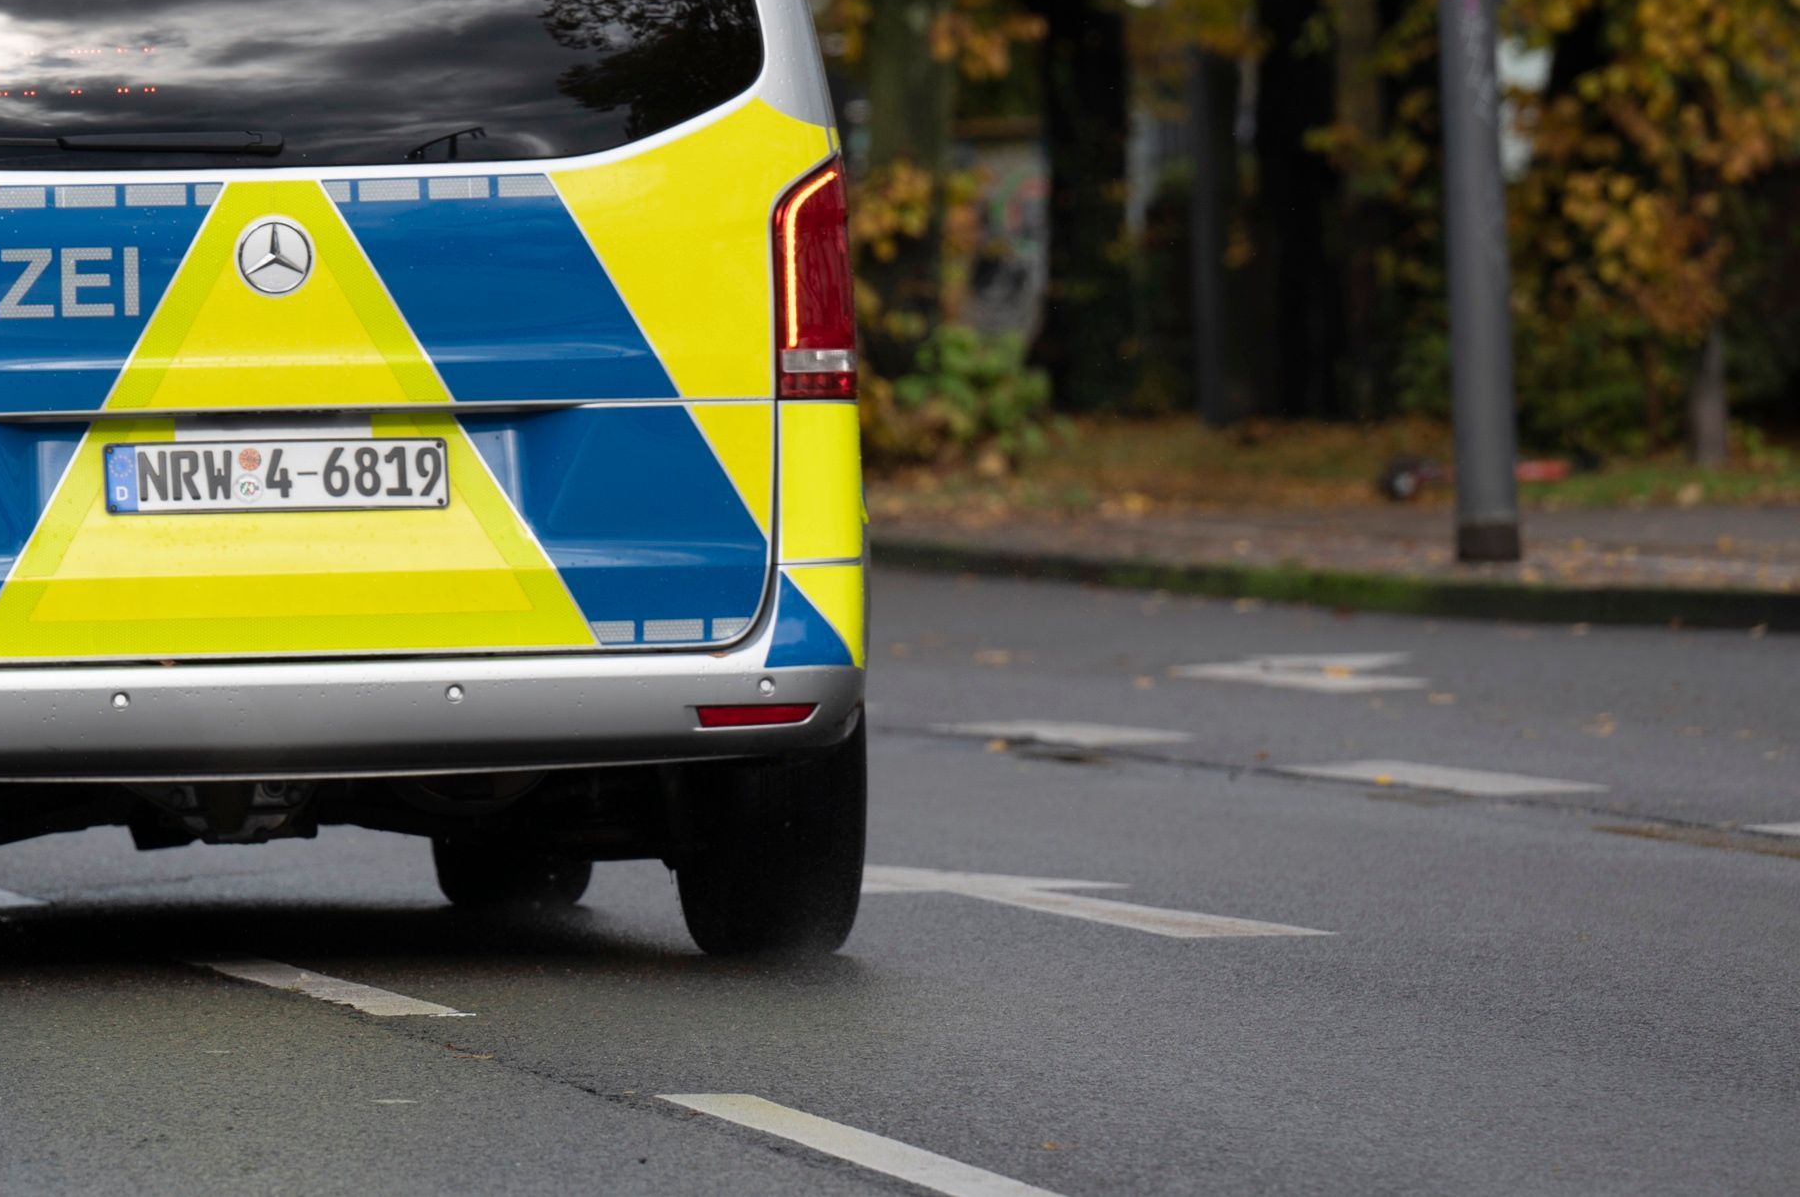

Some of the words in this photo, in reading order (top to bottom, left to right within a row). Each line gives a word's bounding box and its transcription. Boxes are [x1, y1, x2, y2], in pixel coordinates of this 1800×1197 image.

[115, 486, 129, 502] D
[136, 449, 232, 502] NRW
[265, 446, 443, 498] 4-6819
